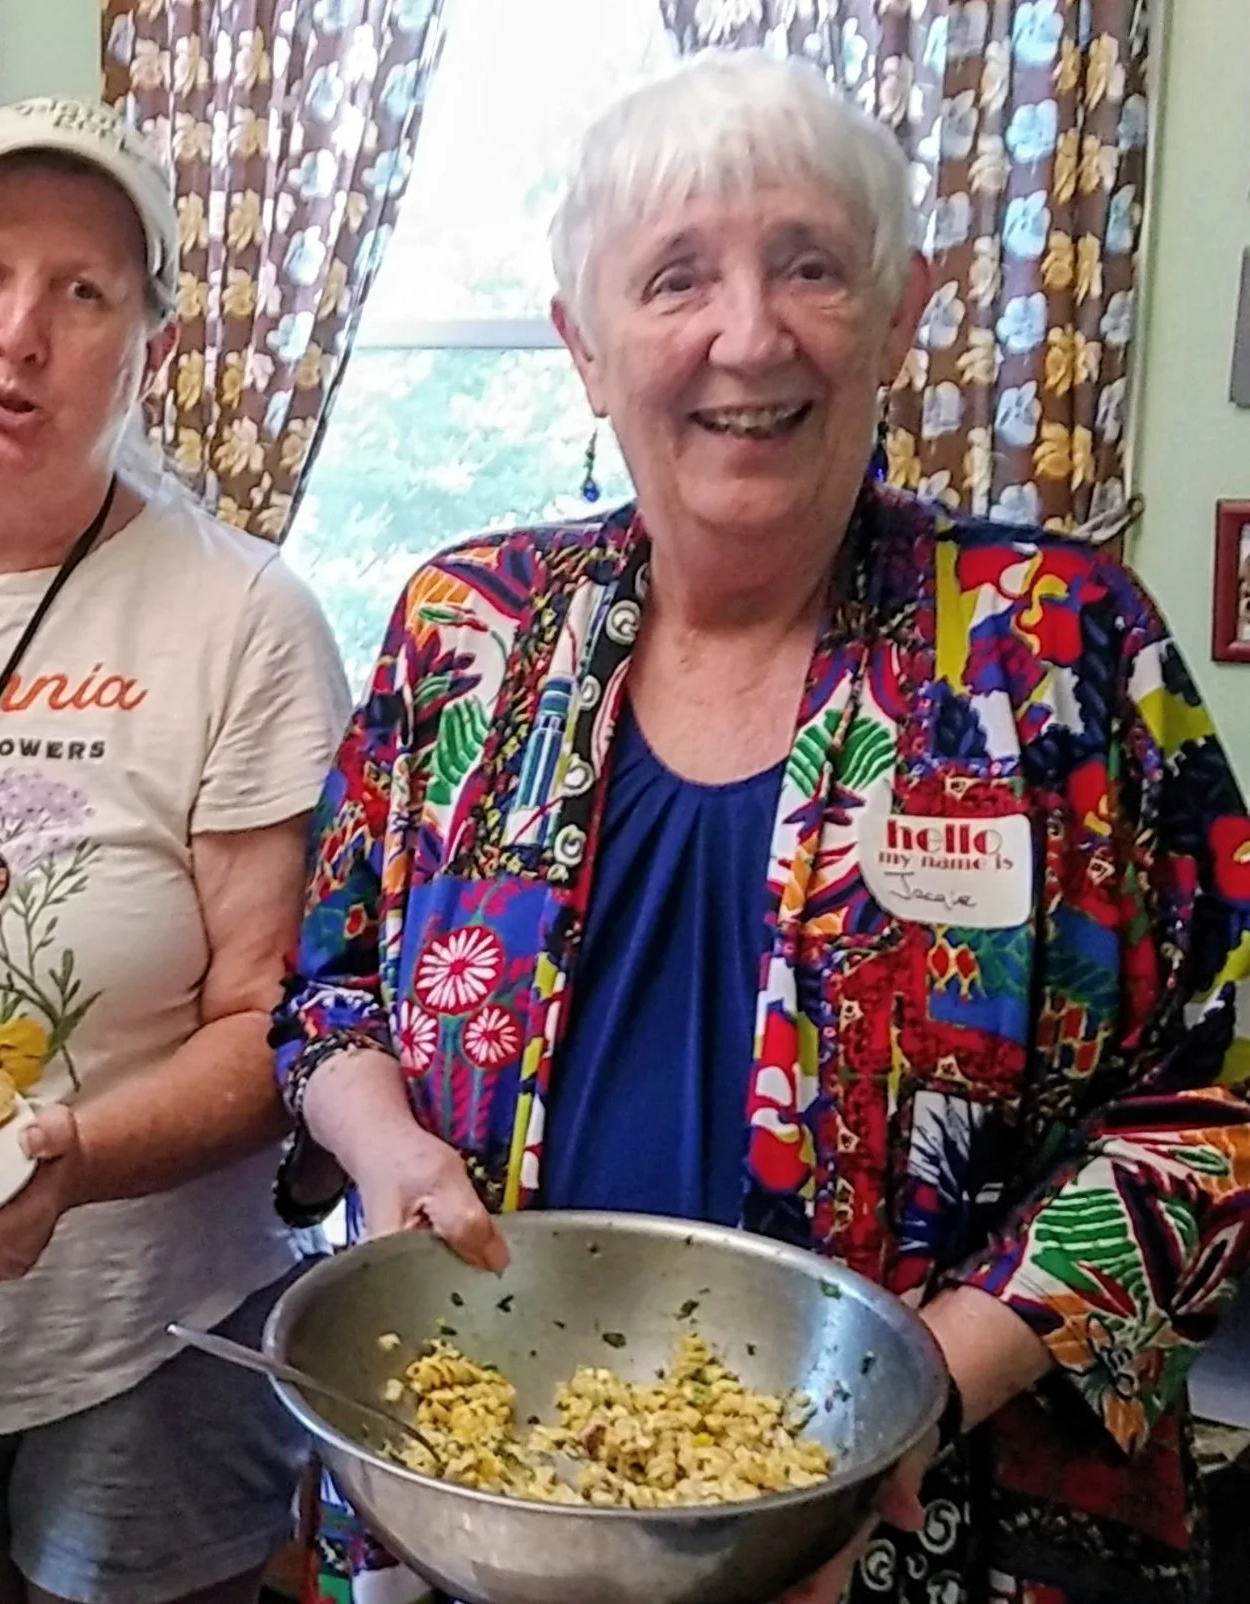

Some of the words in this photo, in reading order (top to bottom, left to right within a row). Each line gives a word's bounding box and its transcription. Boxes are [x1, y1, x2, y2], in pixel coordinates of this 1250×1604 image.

[887, 819, 1003, 855] hello
[879, 852, 910, 868] my
[921, 857, 985, 870] name
[995, 853, 1013, 870] is
